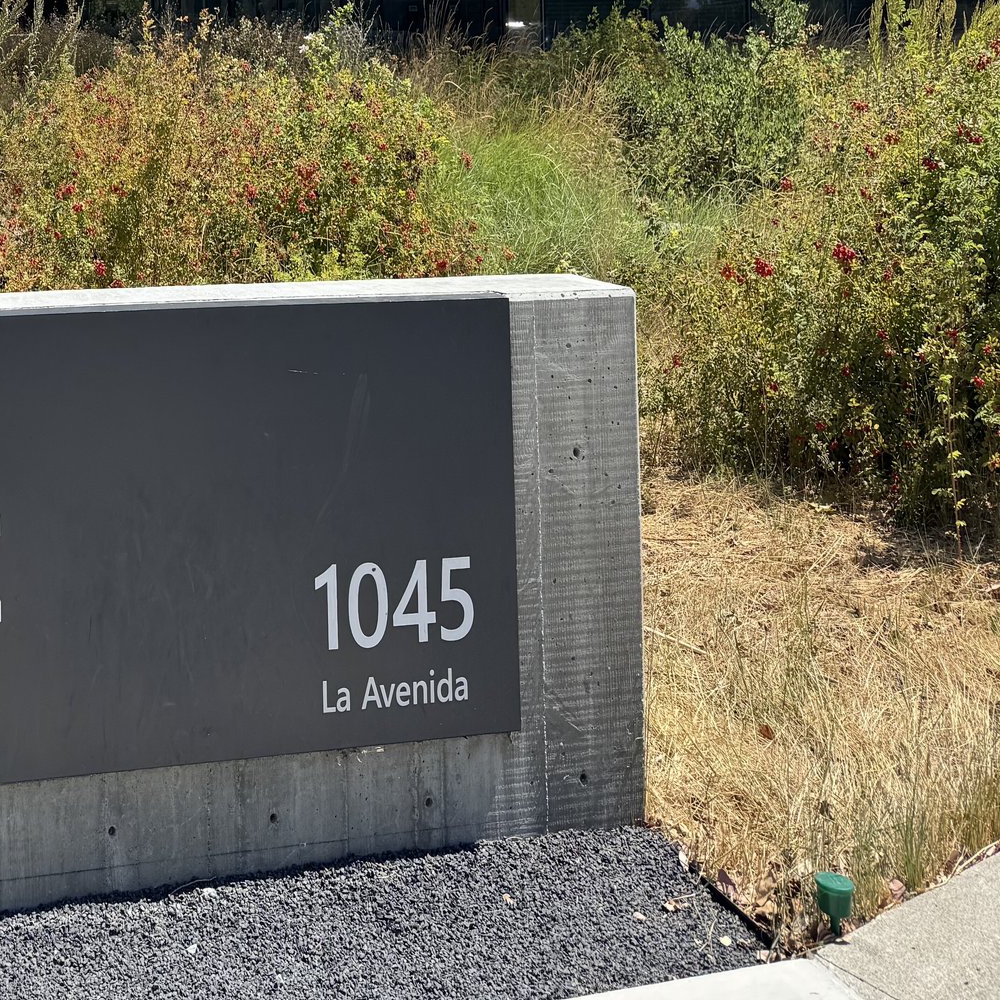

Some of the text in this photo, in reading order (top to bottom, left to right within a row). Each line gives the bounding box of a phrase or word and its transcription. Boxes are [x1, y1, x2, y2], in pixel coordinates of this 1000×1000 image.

[314, 556, 475, 651] 1045
[322, 667, 469, 714] La Avenida
